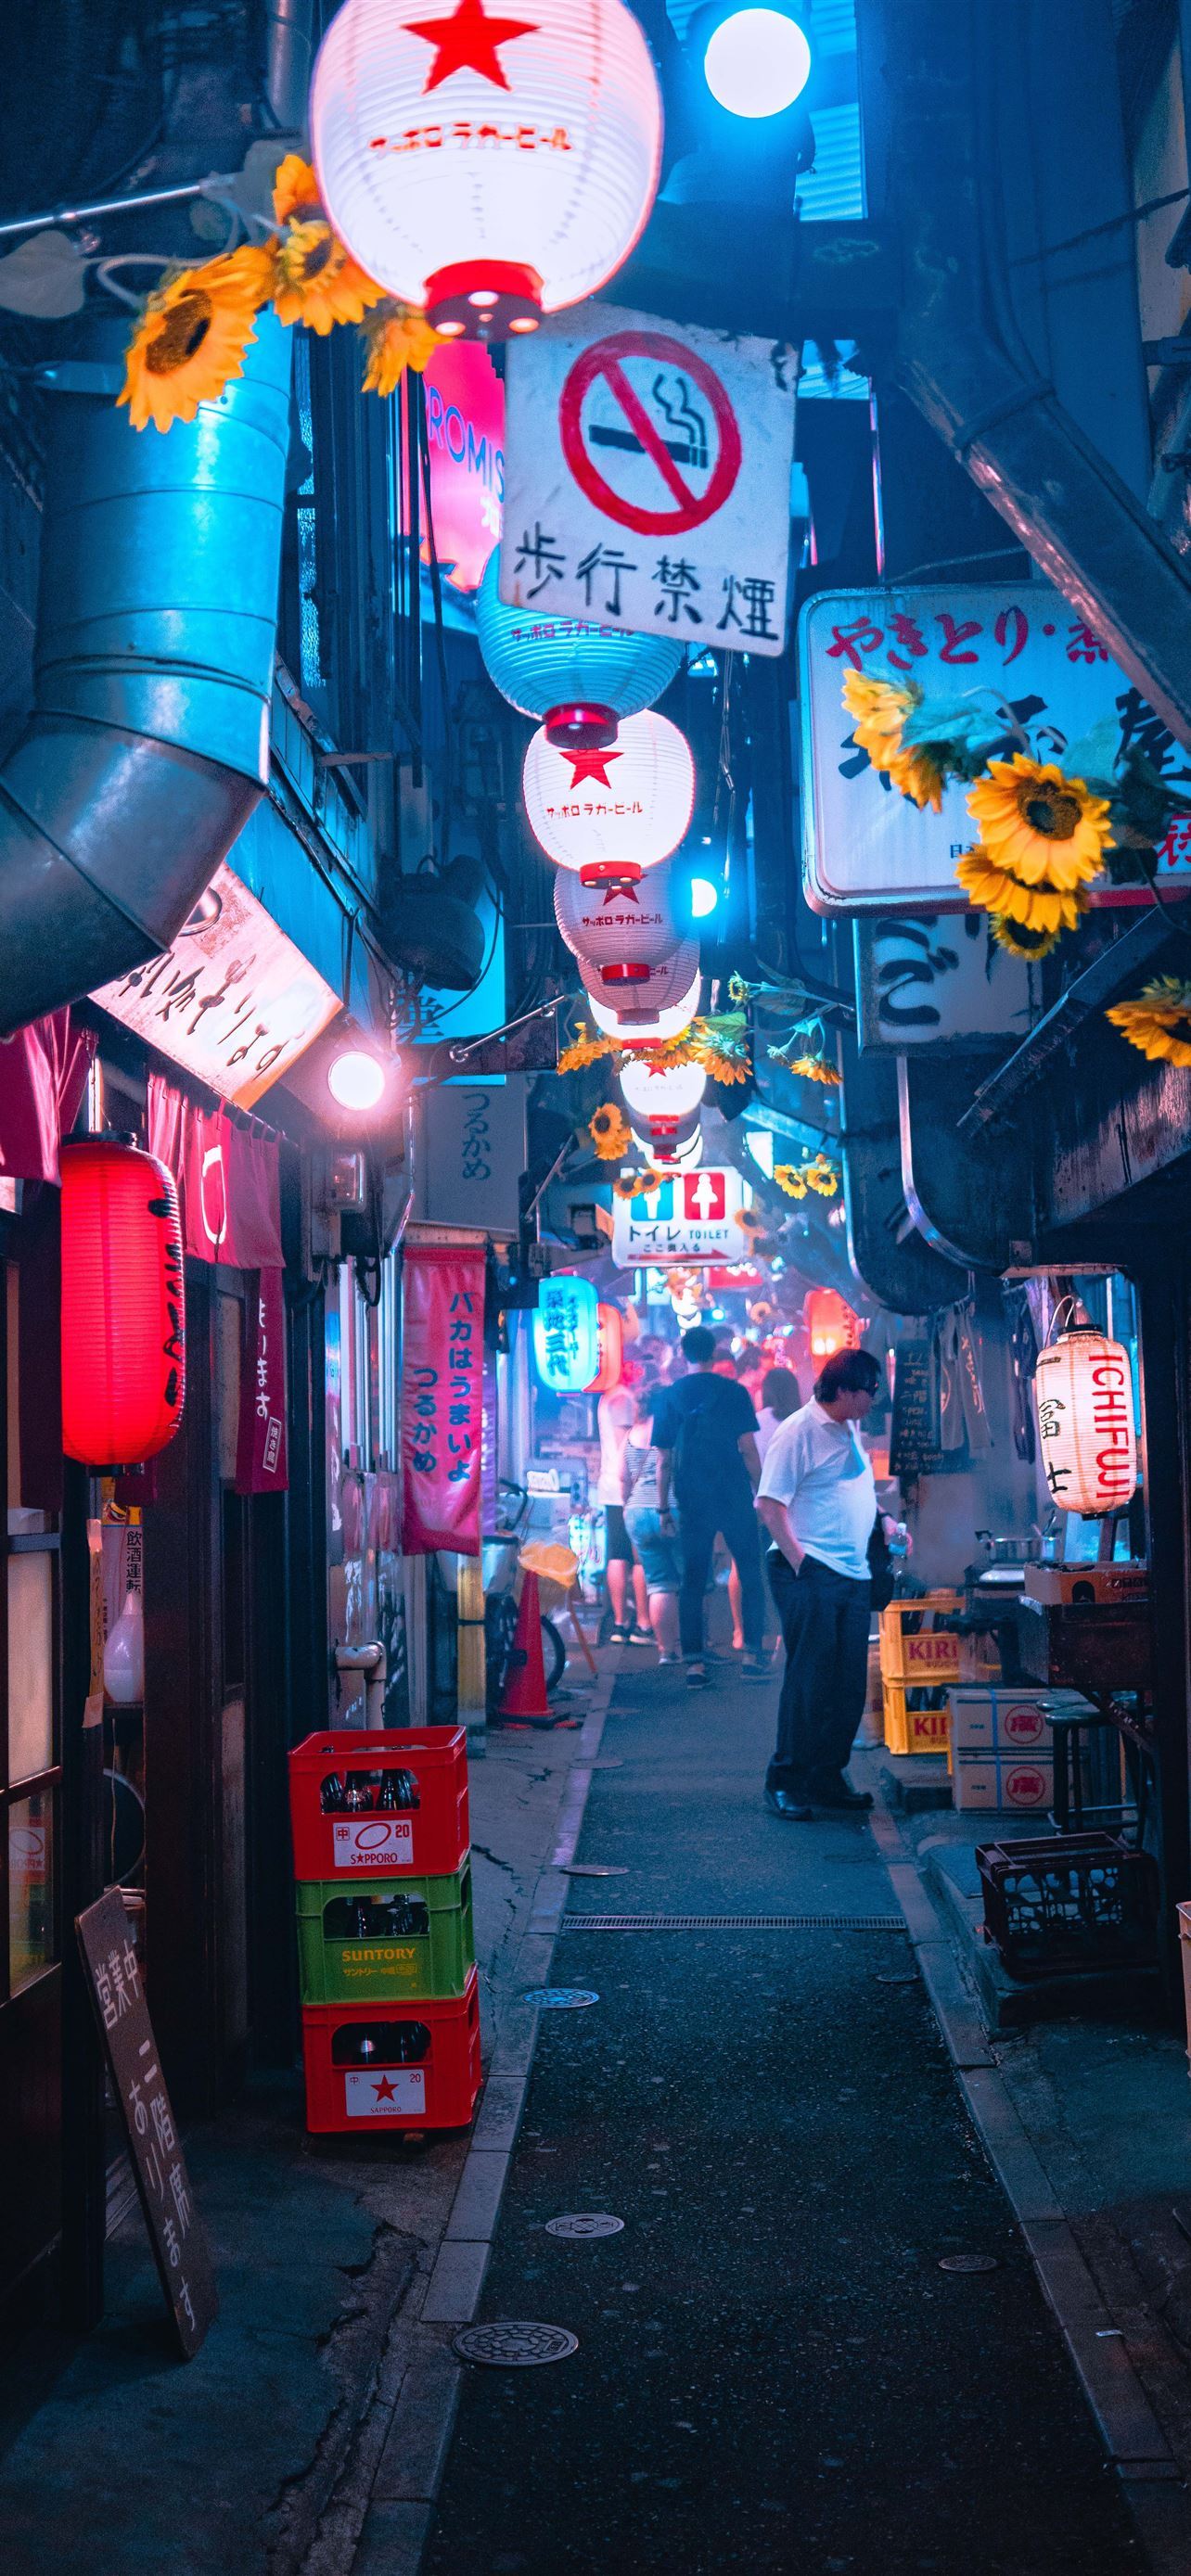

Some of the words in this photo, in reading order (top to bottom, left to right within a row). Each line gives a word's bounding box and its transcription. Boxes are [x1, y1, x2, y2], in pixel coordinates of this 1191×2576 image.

[424, 383, 504, 504] ROMIS
[514, 521, 779, 641] 歩行禁煙
[462, 1092, 491, 1180] つるかめ
[629, 1225, 682, 1243] トイレ
[689, 1230, 729, 1240] TOILET
[413, 1367, 438, 1473] つるかめ
[447, 1292, 474, 1483] バカはうまいよ
[1088, 1354, 1130, 1499] ICHIFUJI
[126, 1530, 142, 1594] 飲酒運転
[395, 1824, 410, 1838] 20
[95, 1939, 140, 2031] 営業中
[371, 2106, 402, 2114] SAPPORO
[409, 2072, 421, 2084] 20
[128, 2079, 196, 2332] あります
